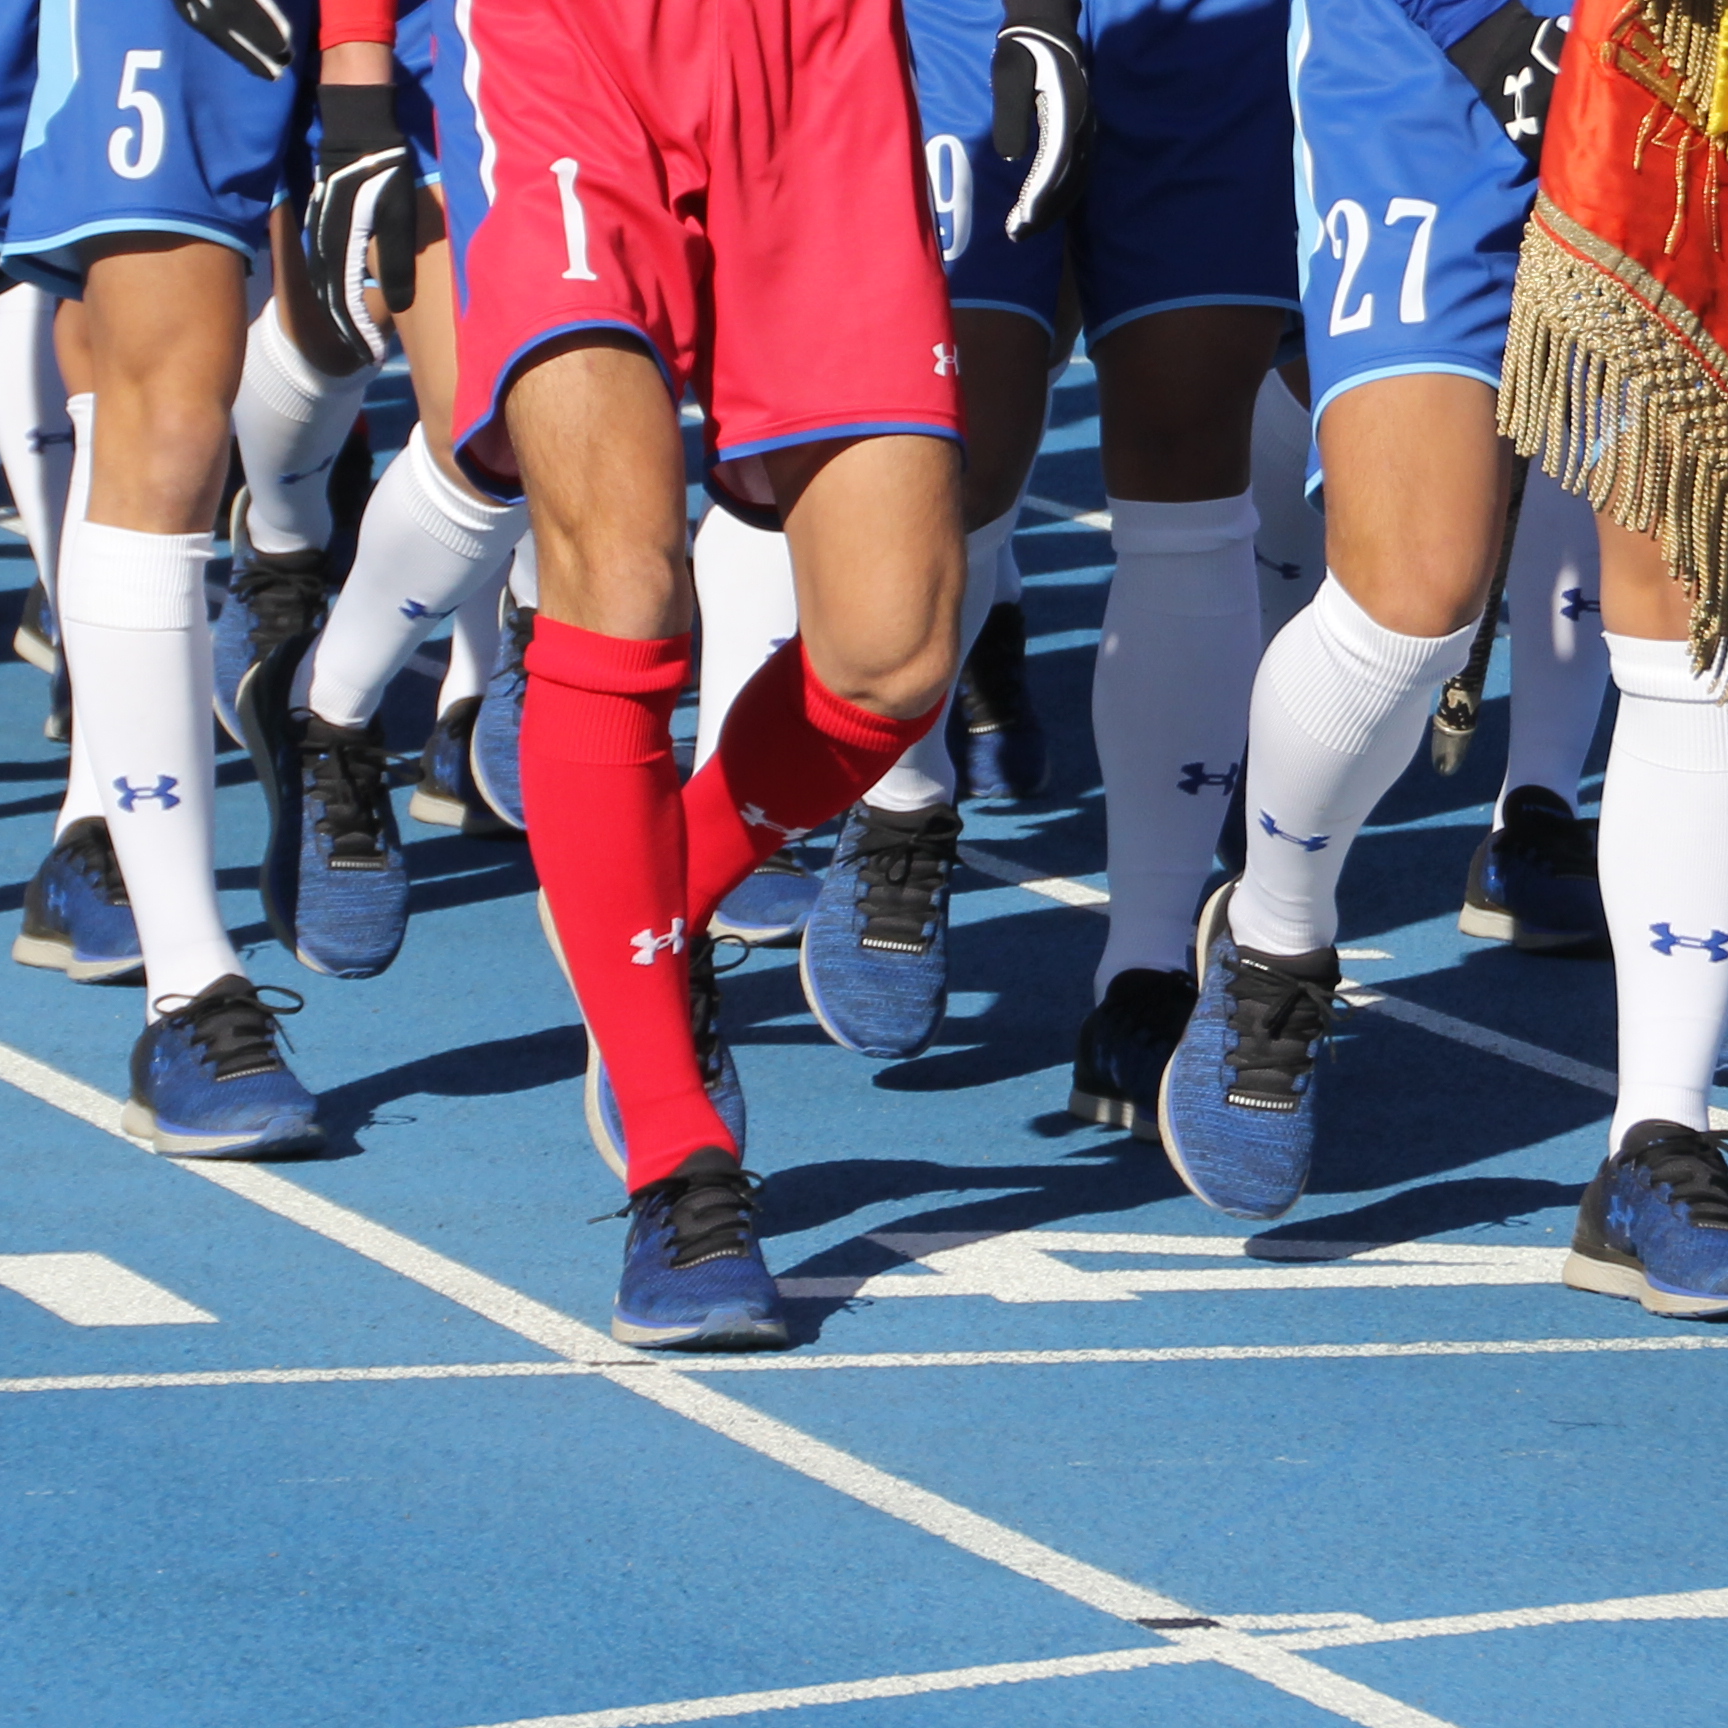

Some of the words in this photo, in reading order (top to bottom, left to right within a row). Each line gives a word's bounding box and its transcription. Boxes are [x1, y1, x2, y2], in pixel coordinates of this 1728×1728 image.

[107, 48, 166, 181] 5
[548, 157, 598, 281] 1
[1328, 197, 1439, 338] 27
